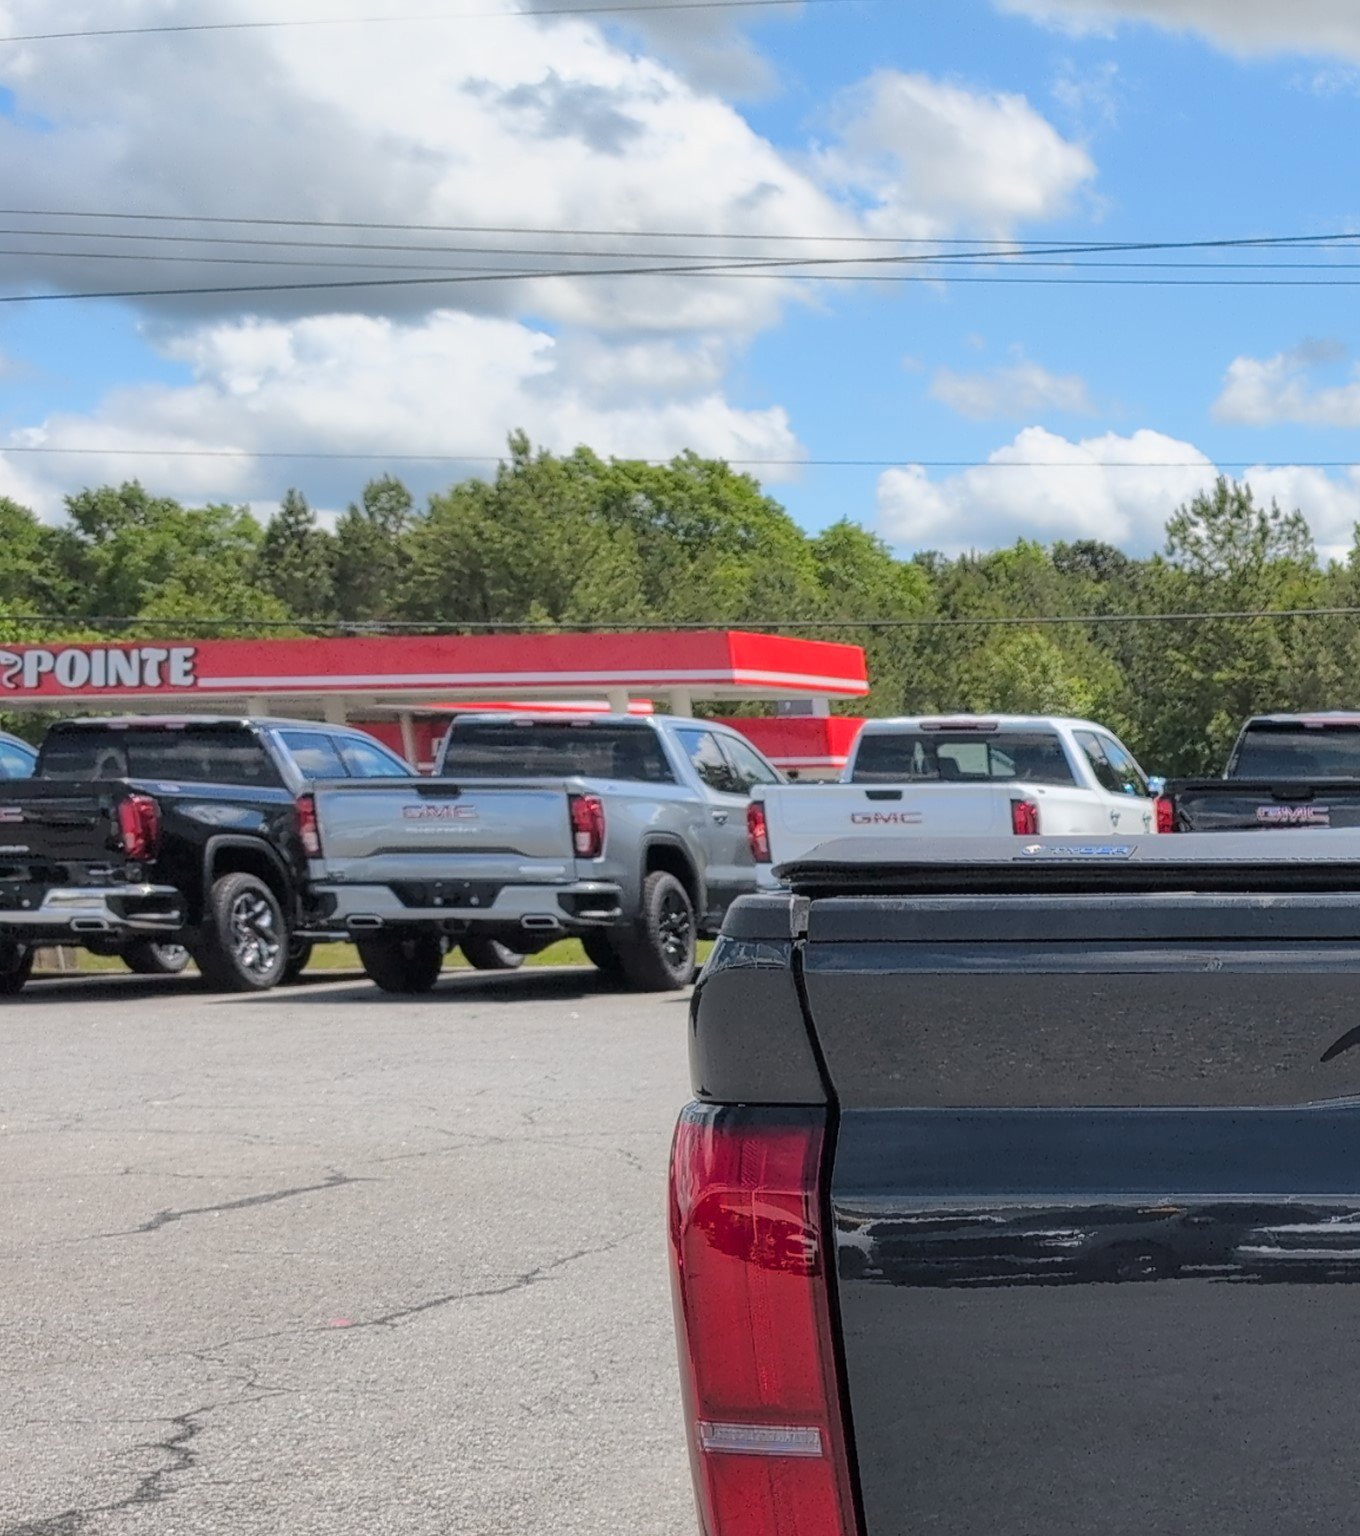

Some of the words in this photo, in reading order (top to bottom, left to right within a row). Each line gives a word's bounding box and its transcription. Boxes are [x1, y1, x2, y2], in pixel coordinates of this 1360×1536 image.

[23, 647, 197, 688] POINTE
[402, 804, 479, 819] GMC
[850, 812, 923, 825] GMC
[1256, 806, 1331, 826] GMC
